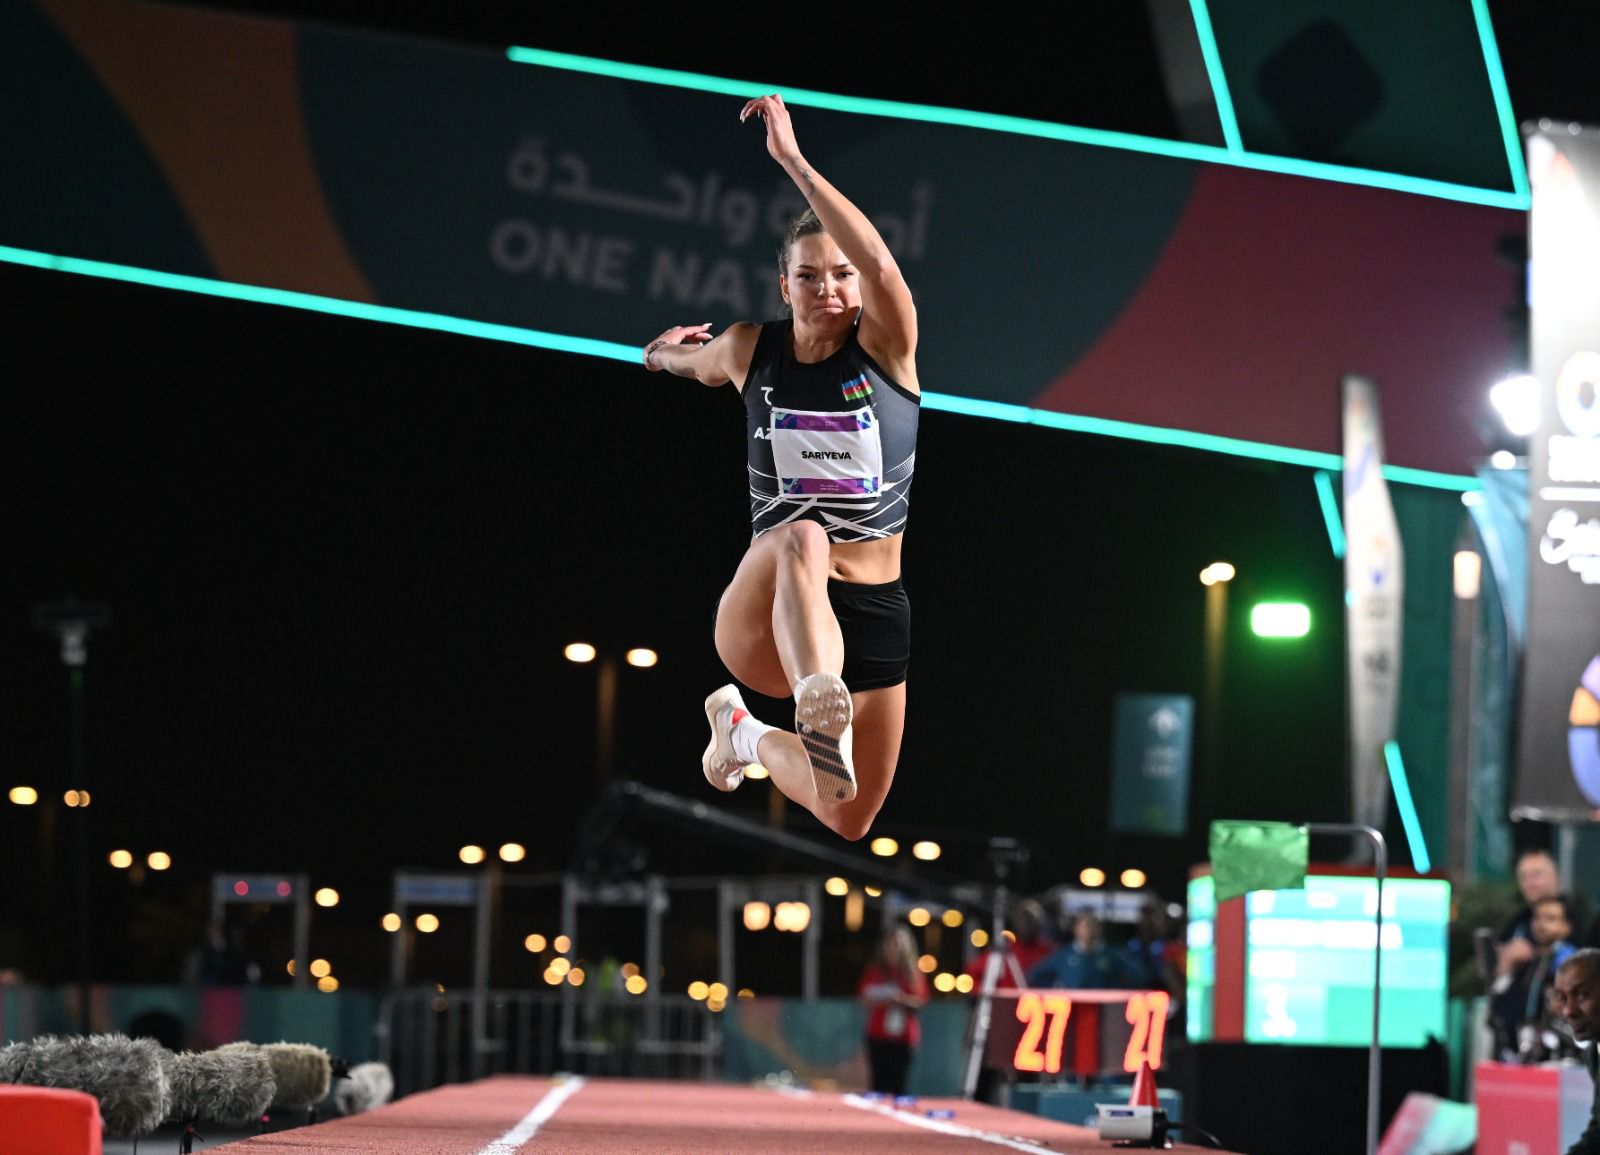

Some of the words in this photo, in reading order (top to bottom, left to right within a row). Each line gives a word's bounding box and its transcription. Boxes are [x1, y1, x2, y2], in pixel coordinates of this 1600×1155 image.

[489, 218, 635, 291] ONE
[646, 247, 783, 320] NAT
[1014, 992, 1072, 1073] 27
[1123, 991, 1170, 1073] 27
